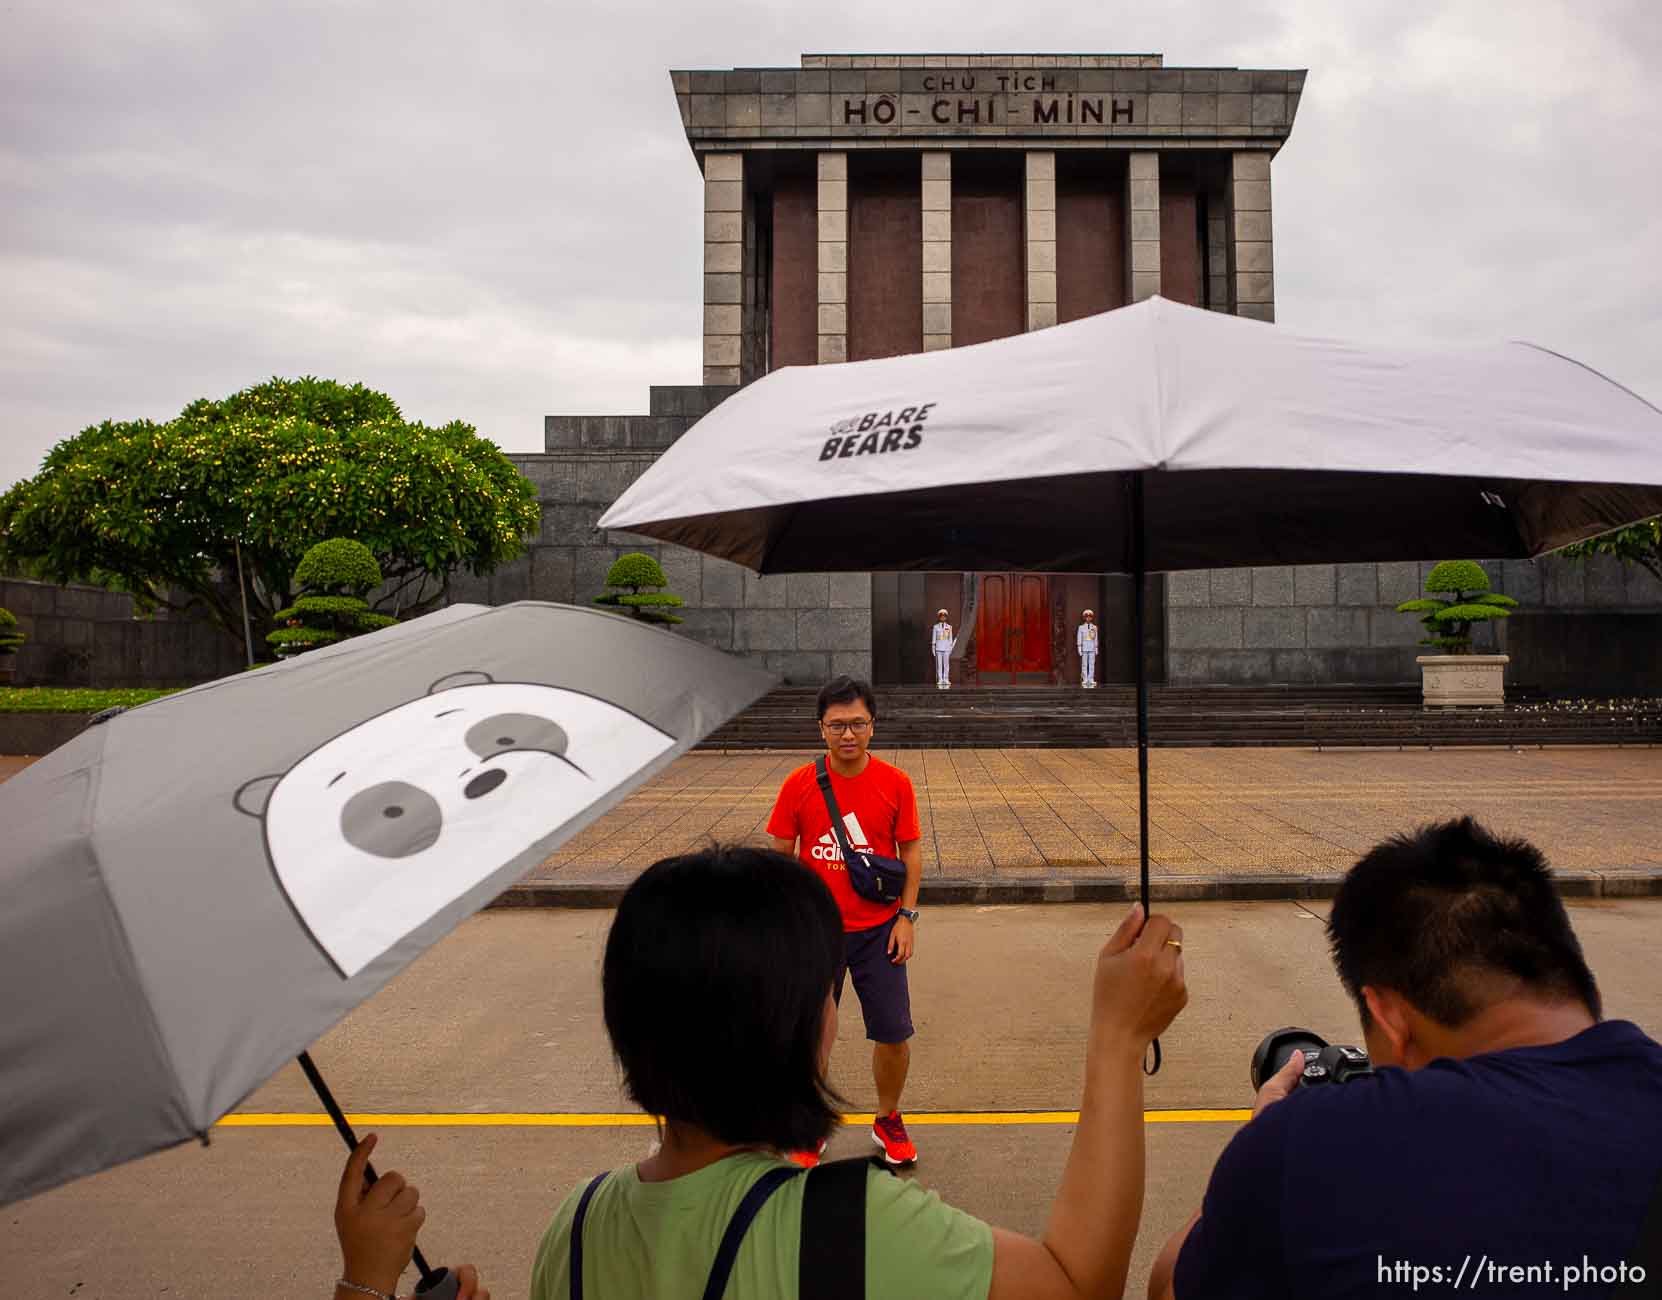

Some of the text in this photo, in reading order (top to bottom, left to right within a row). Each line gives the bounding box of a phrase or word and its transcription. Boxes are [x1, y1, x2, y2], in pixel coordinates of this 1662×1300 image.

[857, 402, 937, 432] BARE
[818, 424, 923, 462] BEARS
[811, 842, 875, 861] adi
[826, 862, 847, 871] TOK
